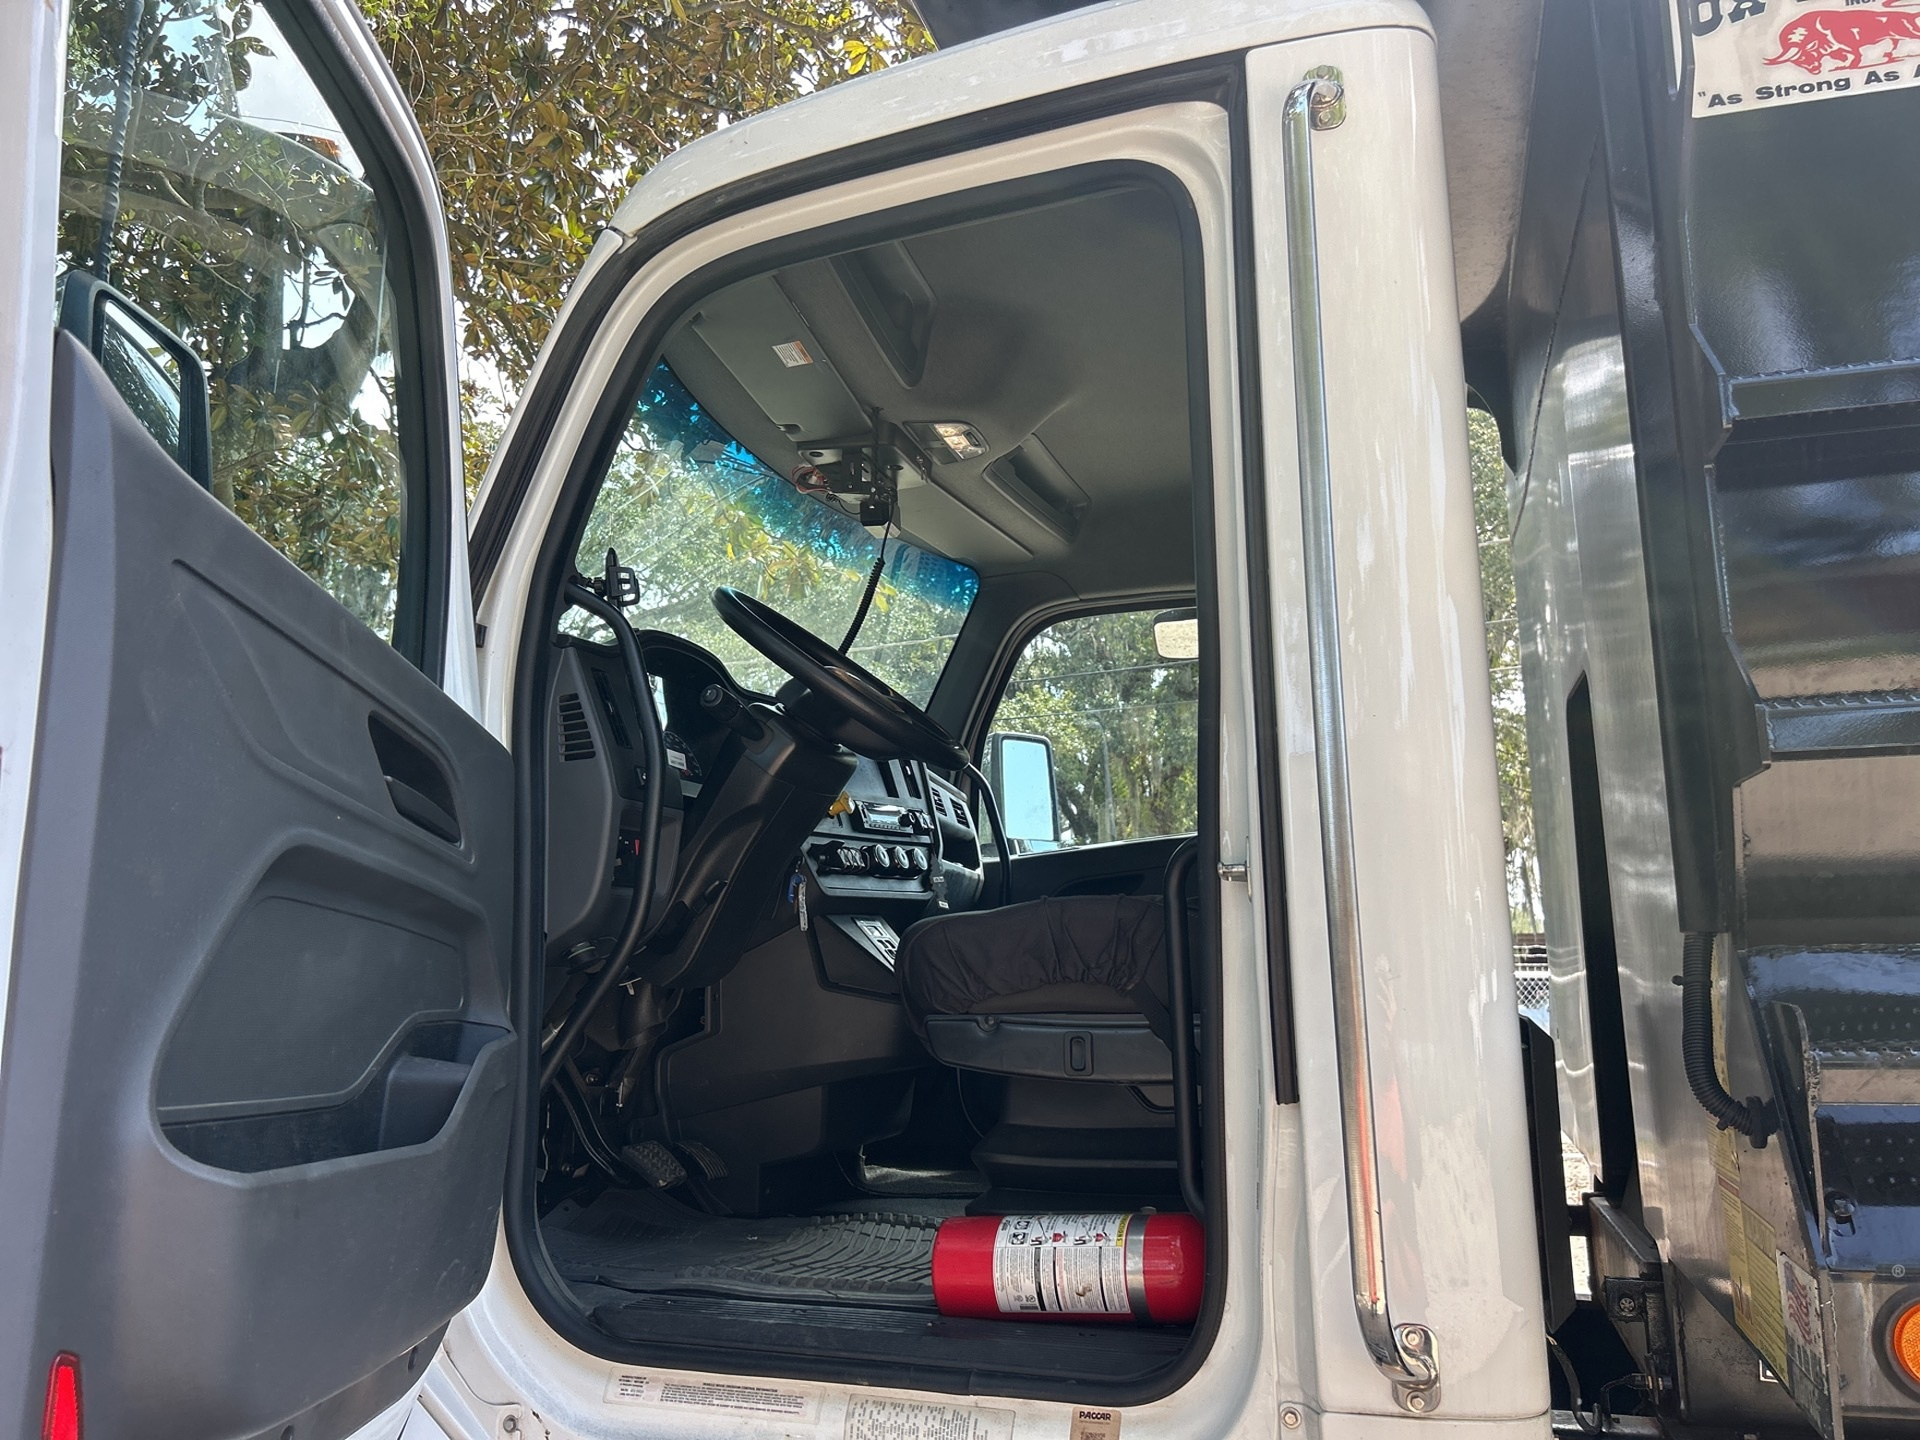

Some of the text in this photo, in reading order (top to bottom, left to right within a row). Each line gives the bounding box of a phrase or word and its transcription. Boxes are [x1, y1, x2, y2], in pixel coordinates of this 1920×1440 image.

[1755, 77, 1851, 100] Strong
[1864, 70, 1900, 85] As
[1079, 1411, 1111, 1421] PACCAR
